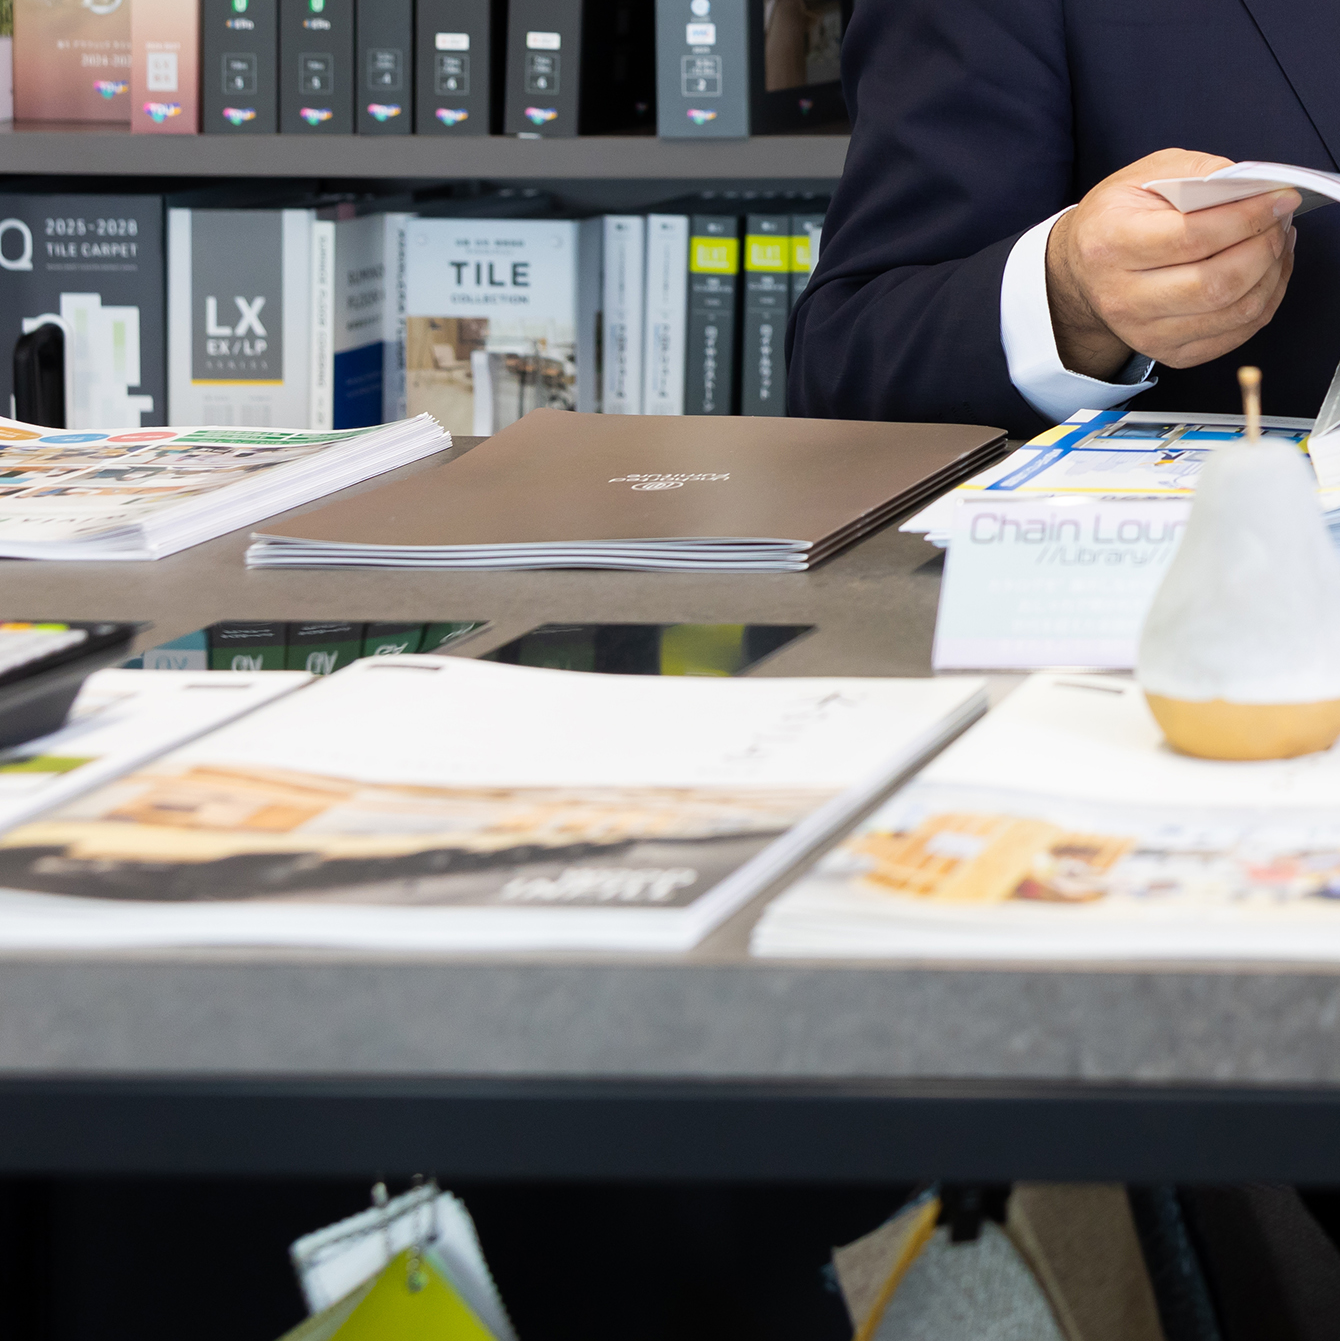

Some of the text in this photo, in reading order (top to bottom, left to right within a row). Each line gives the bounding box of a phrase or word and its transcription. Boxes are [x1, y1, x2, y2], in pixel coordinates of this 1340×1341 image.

[45, 218, 139, 237] 2025-2028
[45, 242, 139, 258] TILE CARPET
[450, 262, 531, 288] TILE
[451, 293, 530, 305] COLLECTION
[205, 296, 268, 338] LX
[969, 512, 1082, 545] Chain
